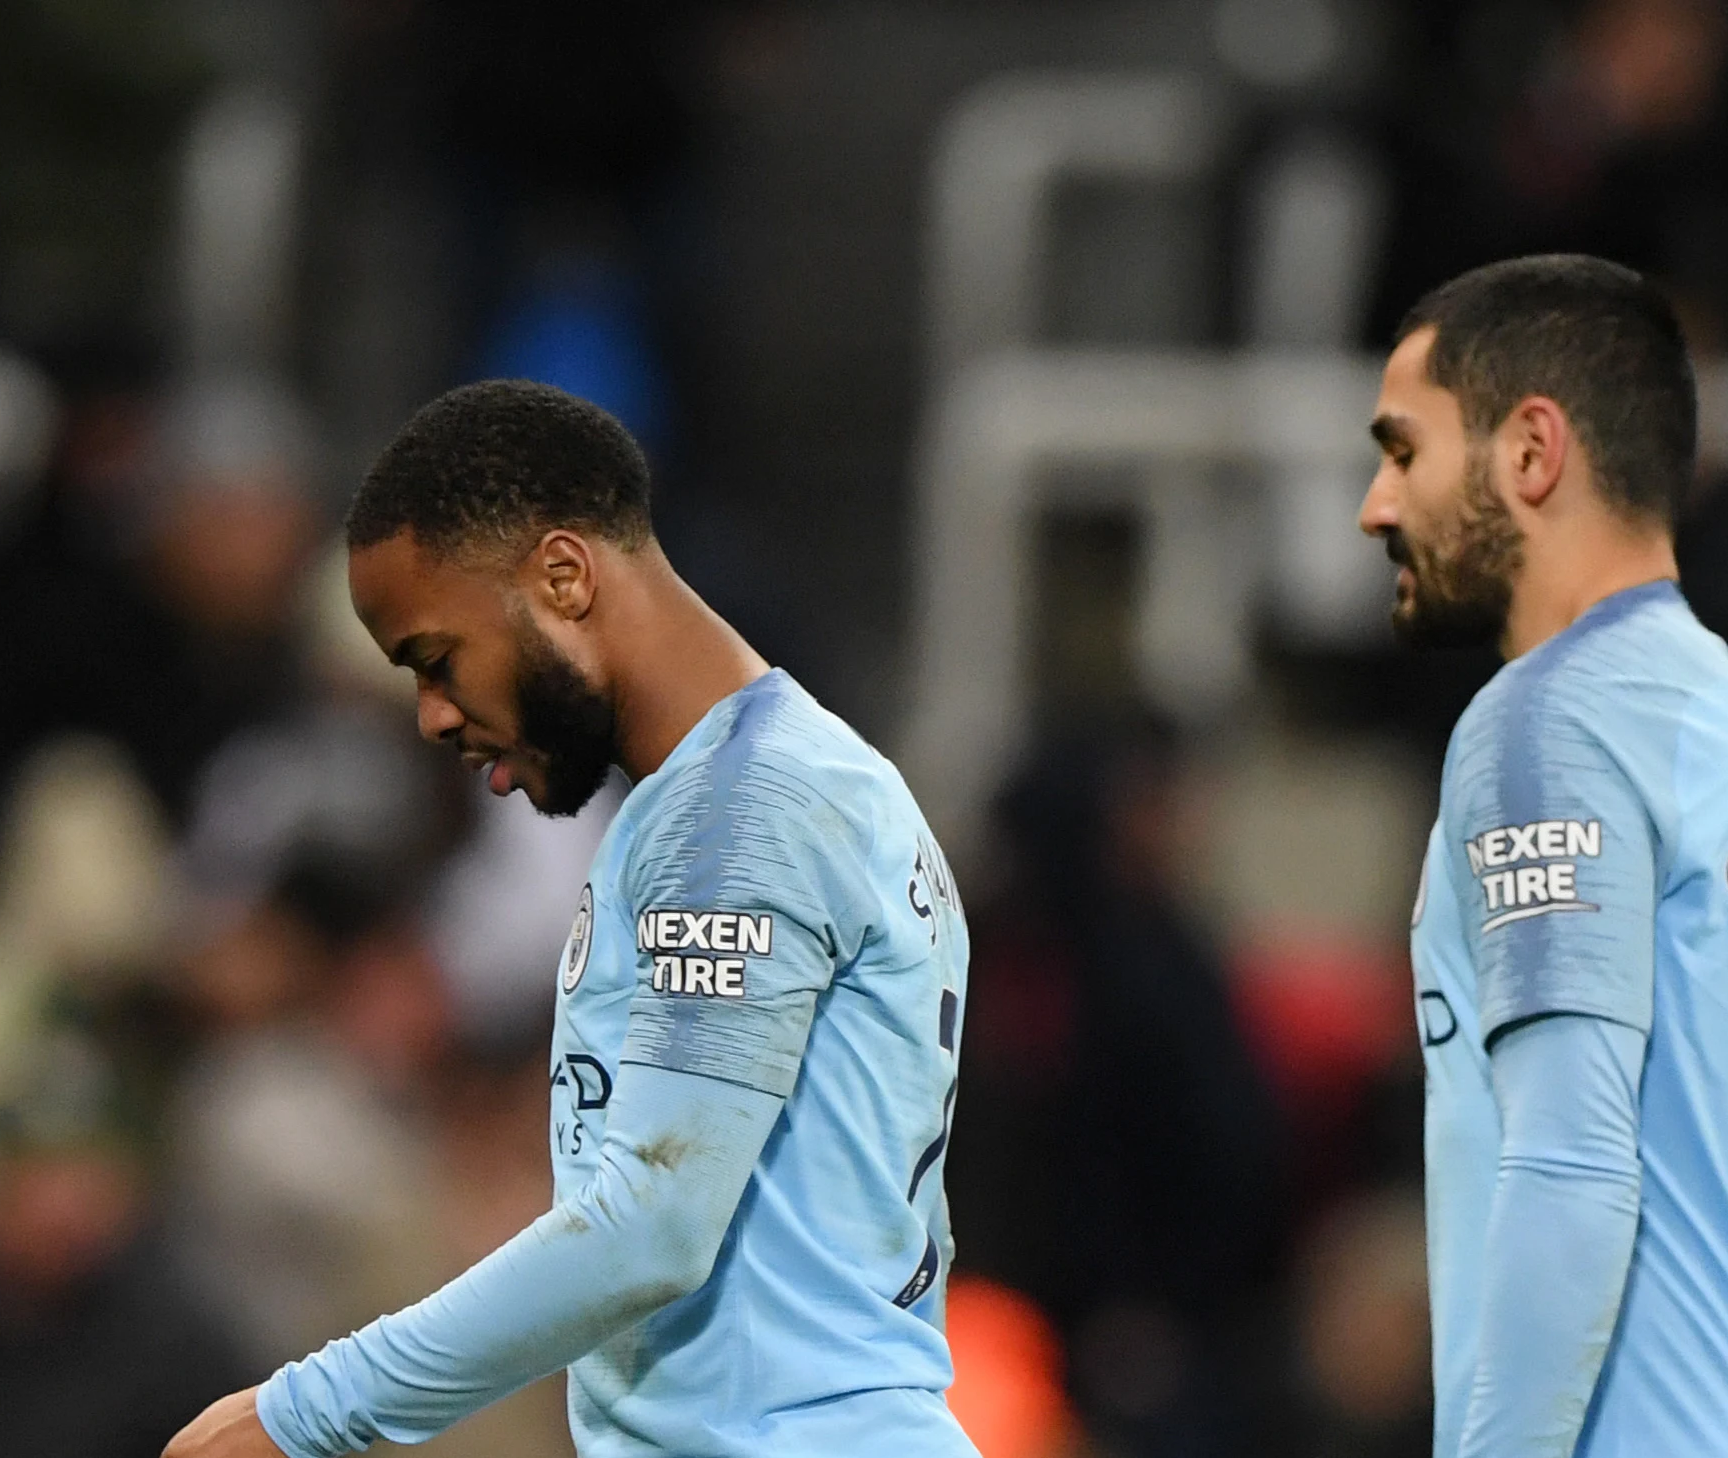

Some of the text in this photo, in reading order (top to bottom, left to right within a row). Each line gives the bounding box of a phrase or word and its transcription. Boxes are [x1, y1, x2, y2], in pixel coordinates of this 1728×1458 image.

[1465, 819, 1602, 877] NEXEN
[1482, 864, 1577, 911] TIRE
[636, 909, 773, 956] NEXEN
[651, 955, 746, 998] TIRE
